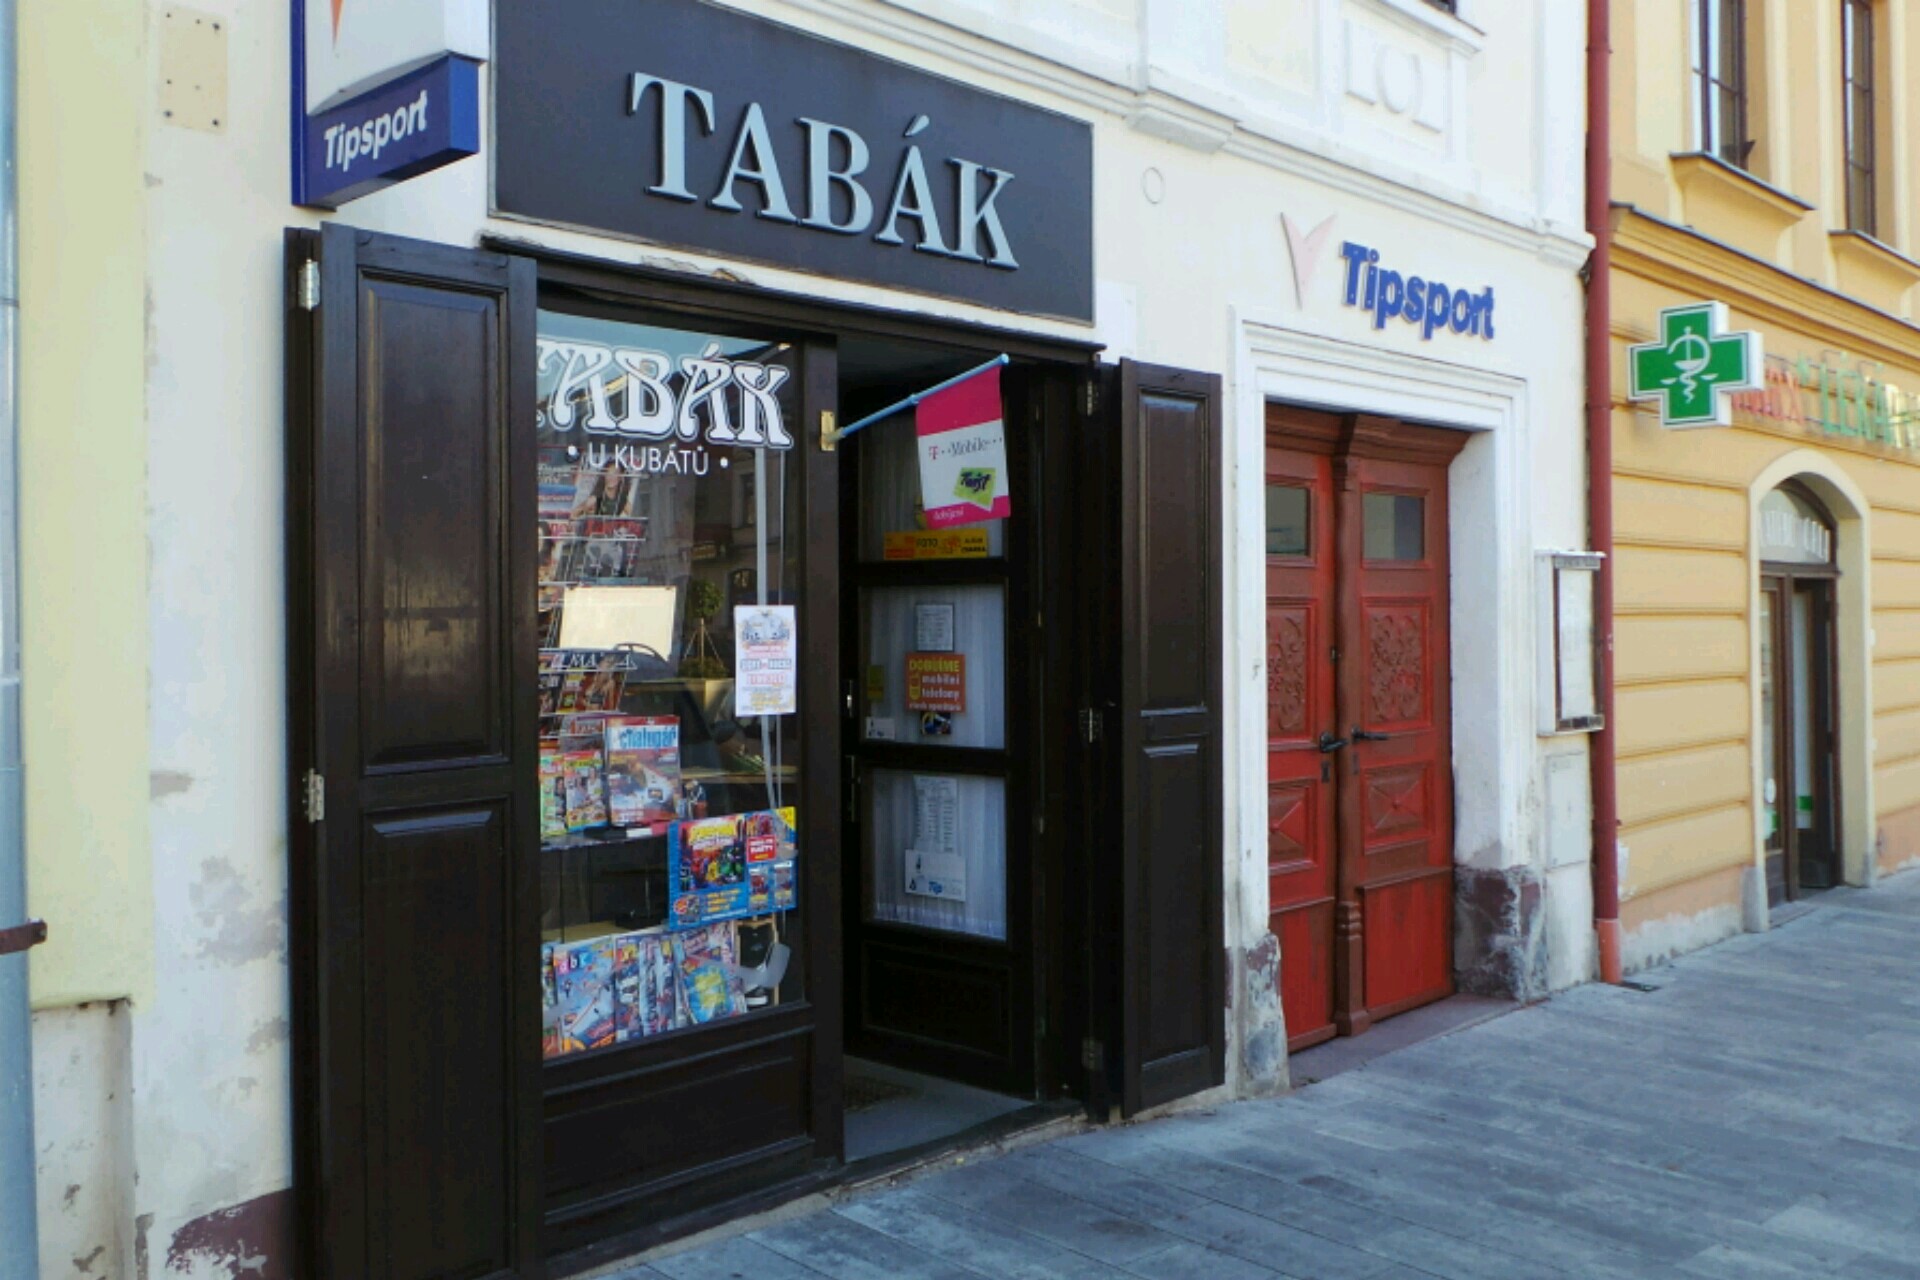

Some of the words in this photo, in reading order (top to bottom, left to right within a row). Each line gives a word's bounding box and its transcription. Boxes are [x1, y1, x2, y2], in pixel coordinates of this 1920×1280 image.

[323, 89, 429, 172] Tipsport
[629, 71, 1019, 270] TABÁK
[1341, 241, 1494, 340] Tipsport
[588, 442, 605, 467] U
[615, 444, 709, 475] KUBÁTŮ
